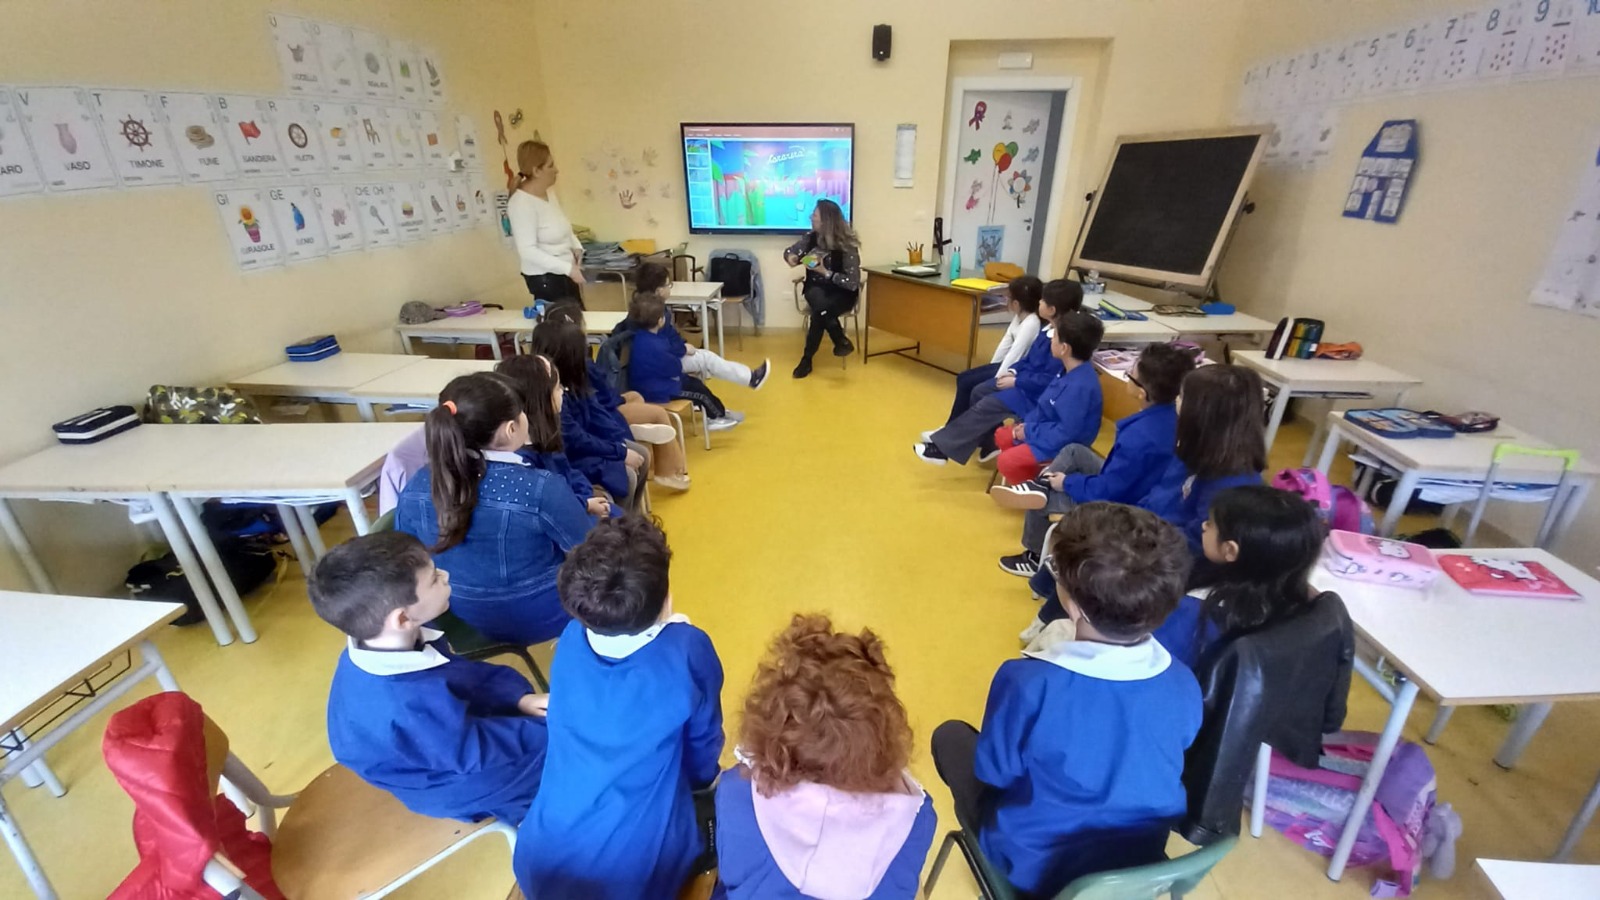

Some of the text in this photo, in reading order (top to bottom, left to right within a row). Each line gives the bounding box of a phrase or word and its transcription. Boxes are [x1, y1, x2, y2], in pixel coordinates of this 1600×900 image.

[1534, 0, 1549, 23] 9
[1486, 9, 1500, 31] 8
[1444, 18, 1458, 39] 7
[1404, 28, 1417, 49] 6
[1367, 38, 1380, 58] 5
[18, 92, 29, 106] V
[92, 93, 102, 106] T
[160, 95, 169, 109] F
[218, 97, 228, 109] B
[216, 193, 230, 206] GI
[269, 189, 286, 201] GE
[313, 187, 322, 198] G
